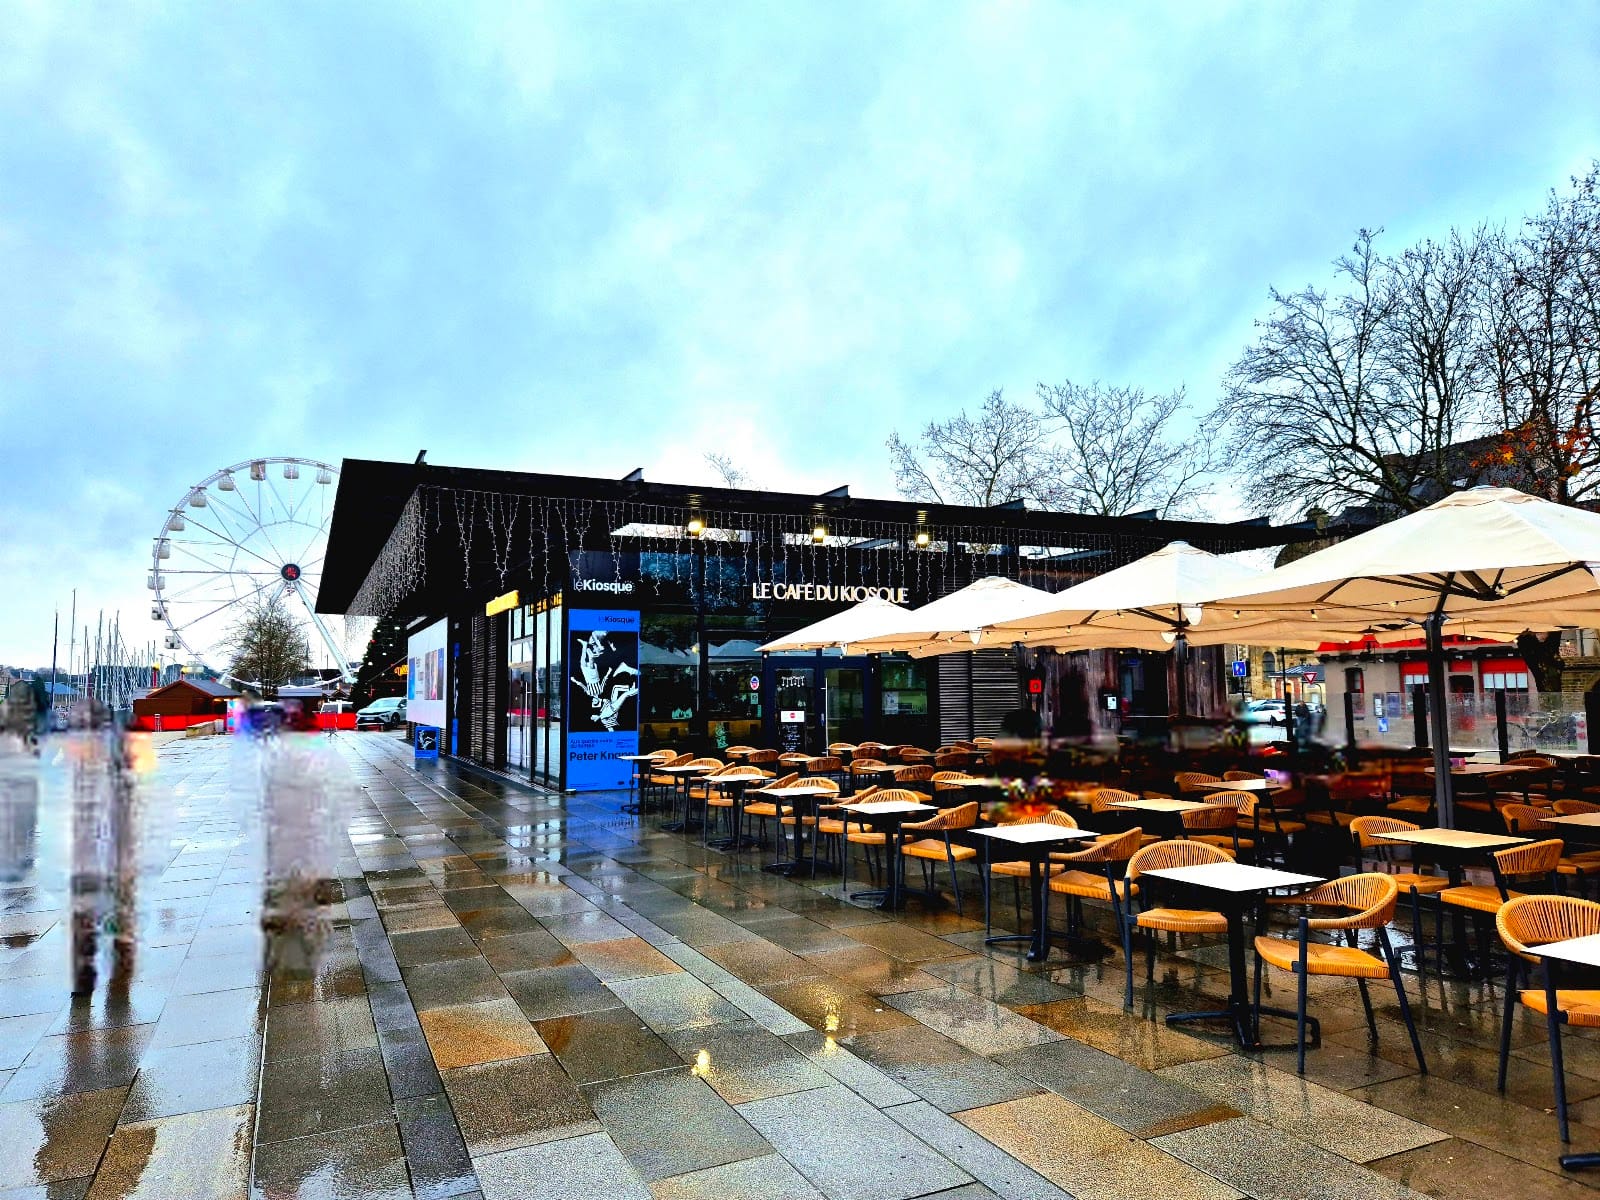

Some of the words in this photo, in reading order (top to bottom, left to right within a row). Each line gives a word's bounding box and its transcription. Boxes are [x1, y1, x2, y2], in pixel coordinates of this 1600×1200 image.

[752, 582, 771, 599] LE
[773, 582, 814, 600] CAFÉ
[816, 584, 838, 601] DU
[841, 585, 910, 603] KIOSQUE
[569, 751, 598, 762] Peter
